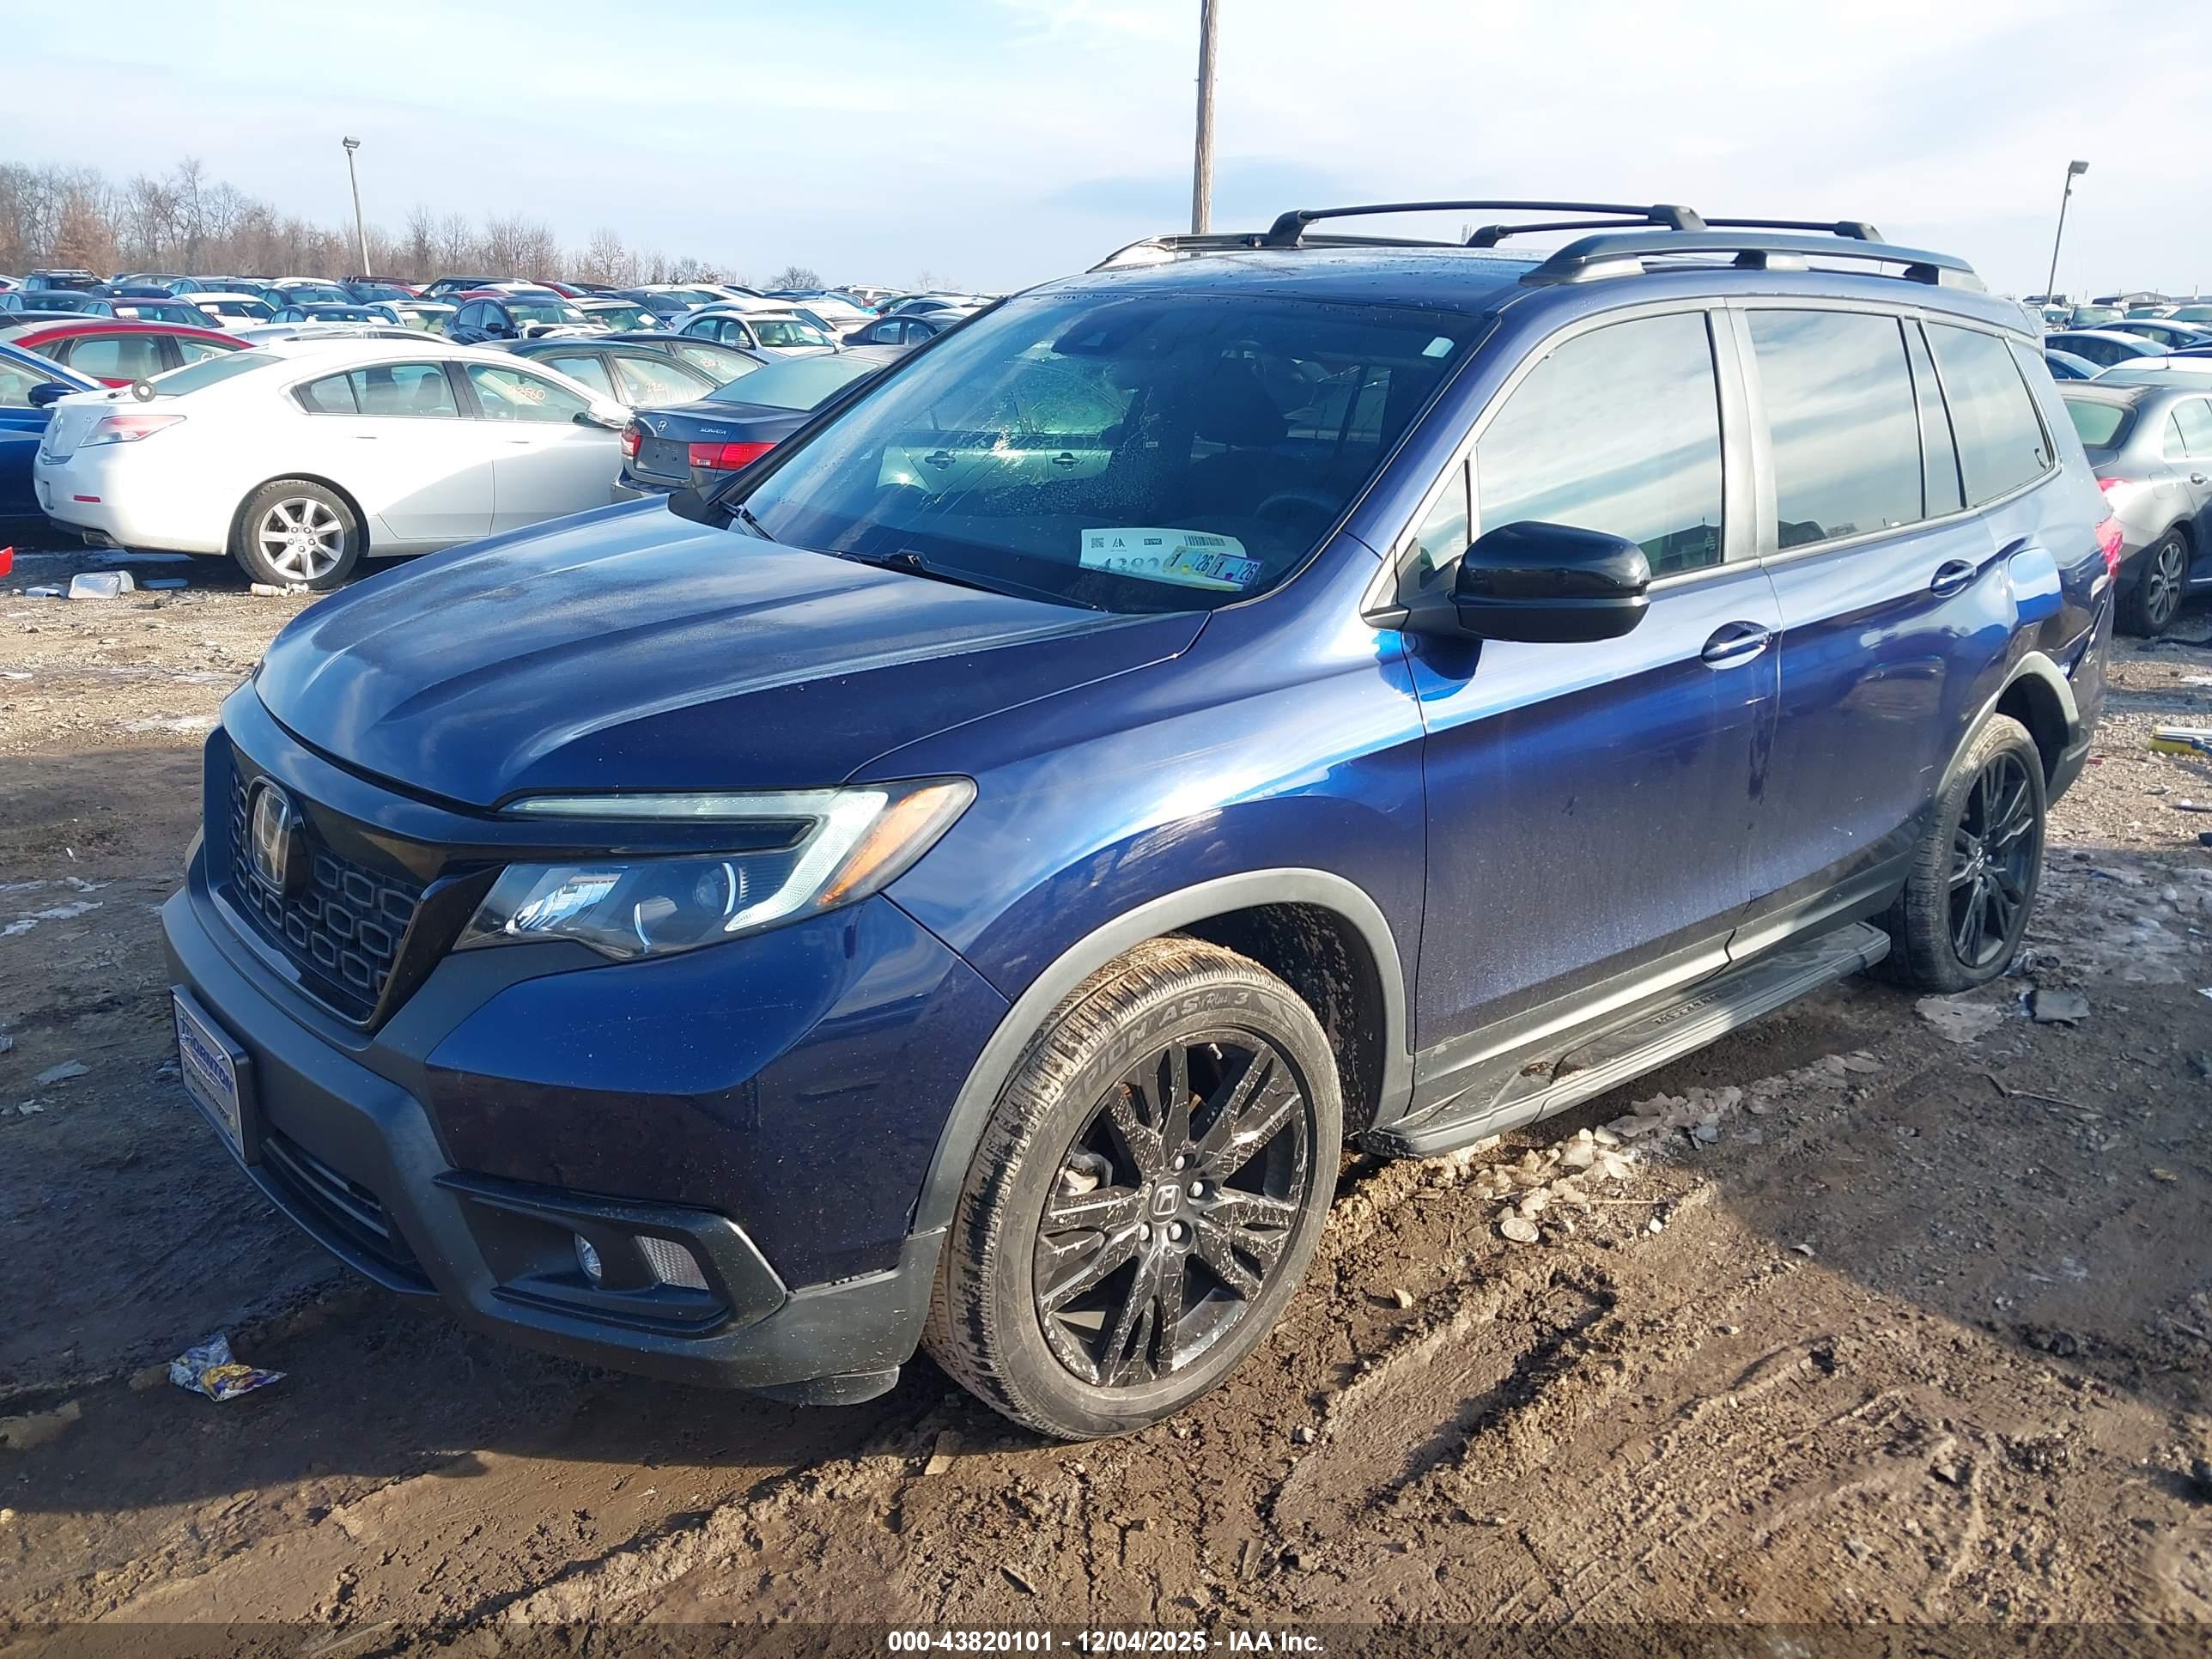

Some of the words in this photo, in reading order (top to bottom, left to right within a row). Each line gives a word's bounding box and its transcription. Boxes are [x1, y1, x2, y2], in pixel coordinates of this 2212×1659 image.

[1195, 554, 1214, 572] 26
[1239, 563, 1258, 581] 26
[1233, 991, 1250, 1006] 3
